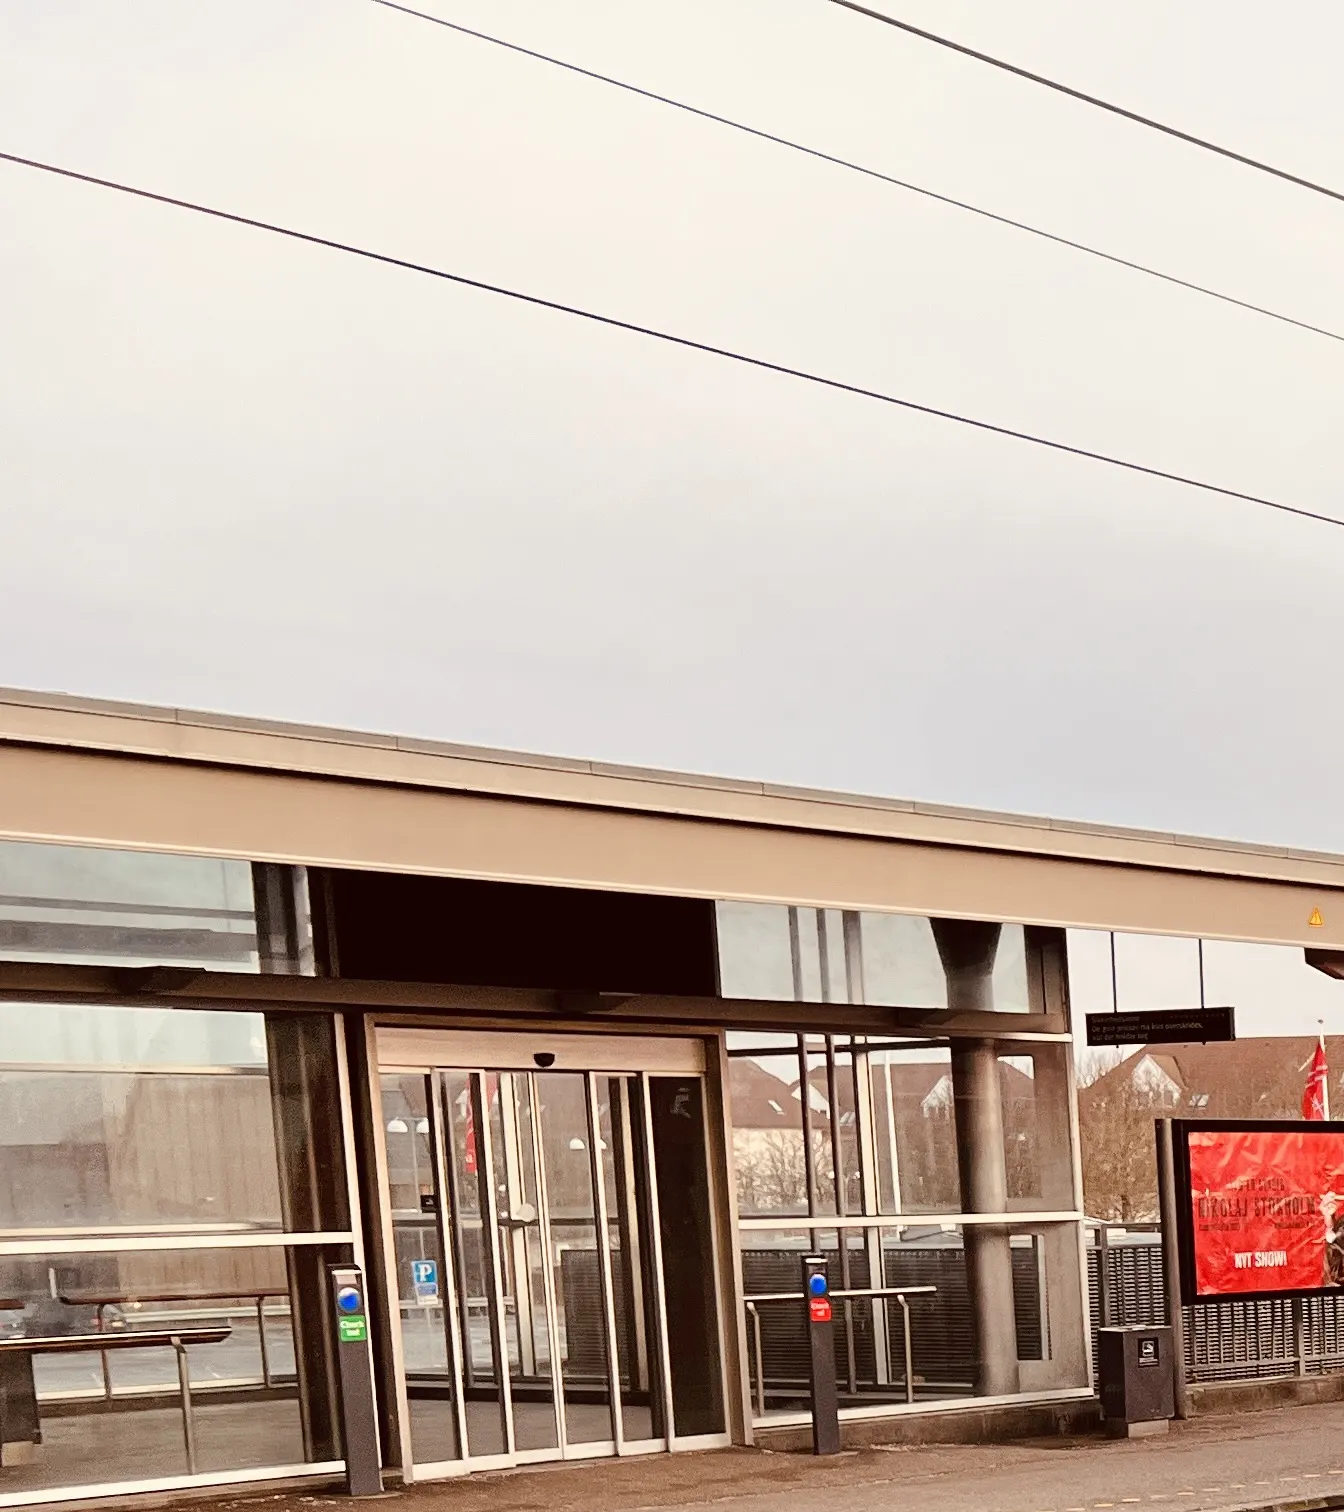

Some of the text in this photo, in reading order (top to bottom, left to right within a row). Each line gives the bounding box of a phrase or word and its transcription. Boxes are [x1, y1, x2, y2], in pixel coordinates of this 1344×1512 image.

[1235, 1251, 1287, 1268] NYT SHOW!
[418, 1263, 432, 1282] P
